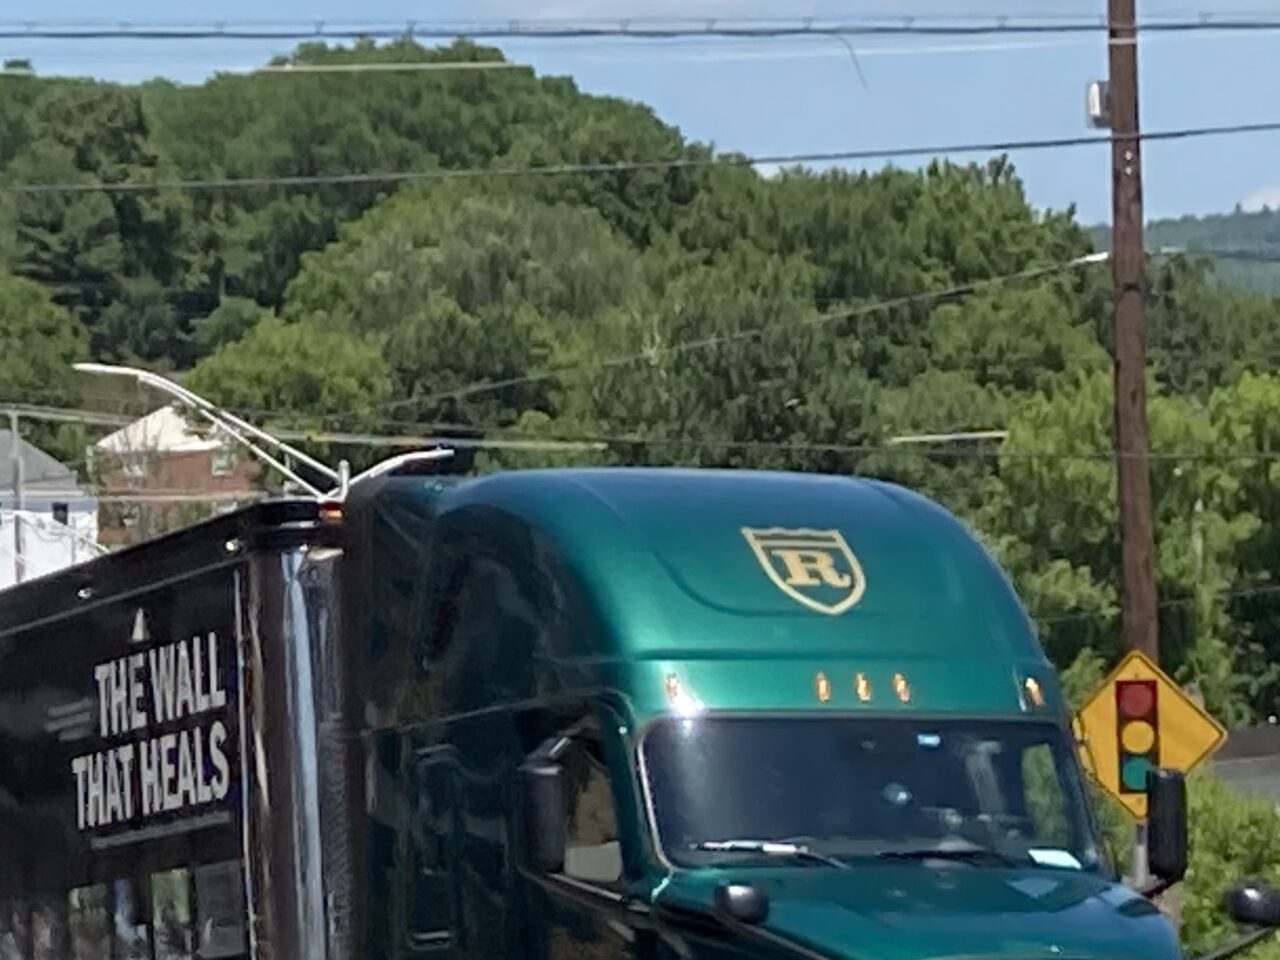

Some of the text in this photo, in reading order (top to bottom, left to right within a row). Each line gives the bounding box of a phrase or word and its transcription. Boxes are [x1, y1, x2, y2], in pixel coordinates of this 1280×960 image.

[771, 549, 852, 588] R
[94, 653, 148, 738] THE
[149, 632, 226, 723] WALL
[72, 743, 134, 830] THAT
[140, 720, 230, 817] HEALS
